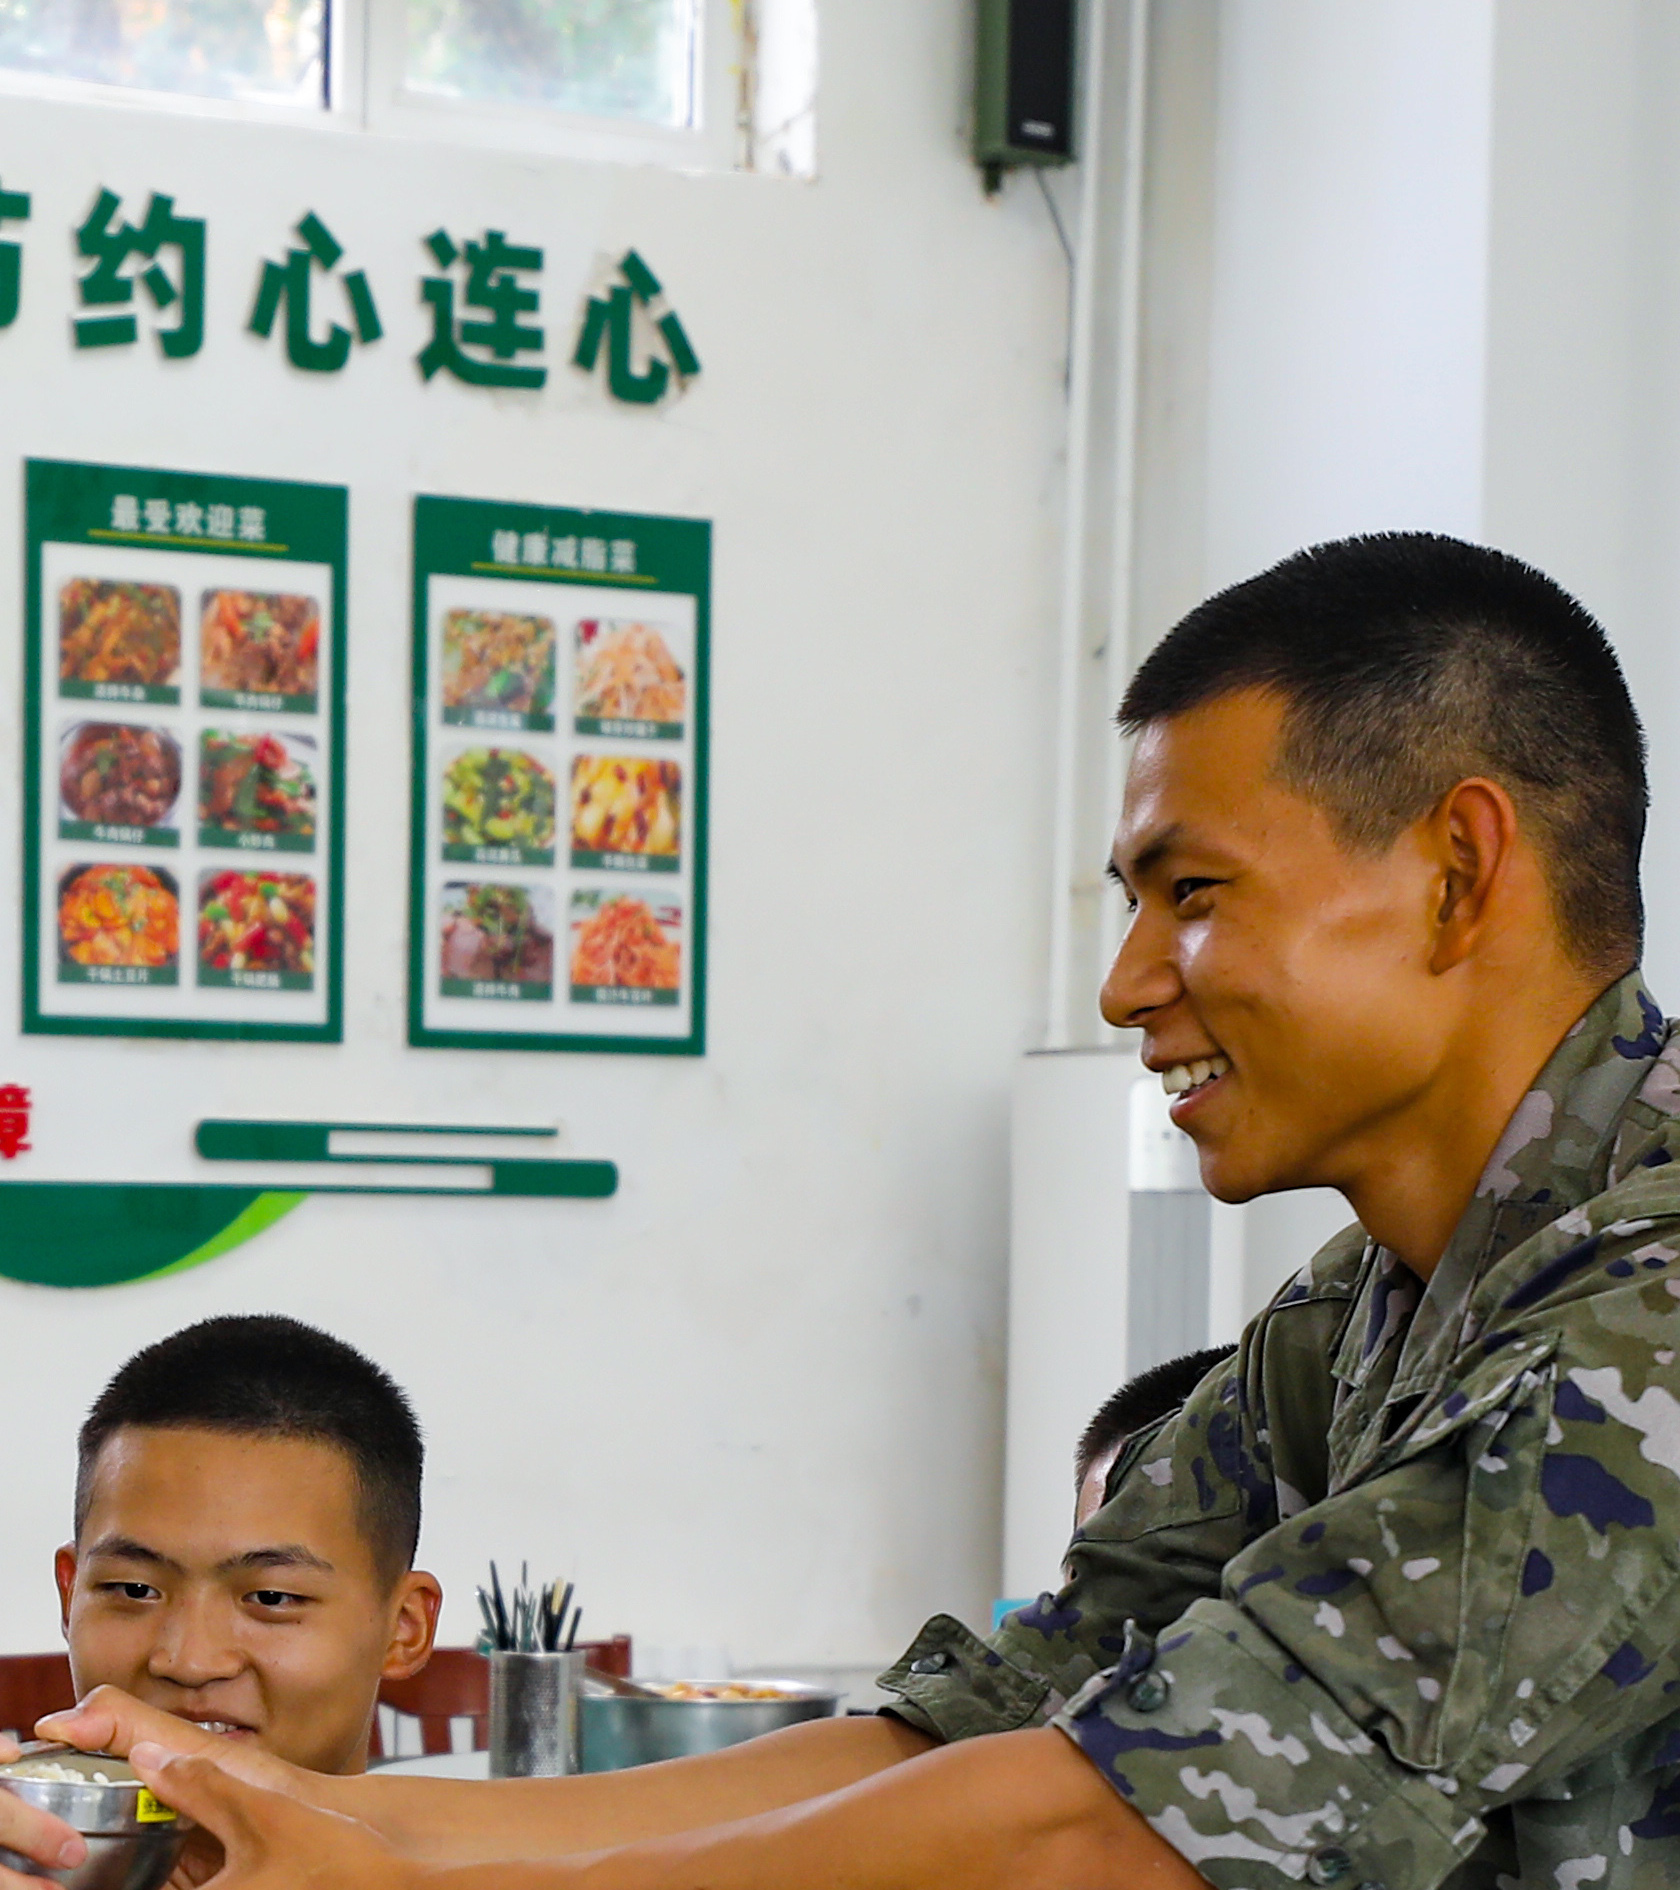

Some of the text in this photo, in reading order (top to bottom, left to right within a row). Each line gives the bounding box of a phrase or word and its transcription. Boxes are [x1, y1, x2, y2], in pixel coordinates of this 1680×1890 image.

[109, 494, 267, 541] 最受欢迎菜
[490, 529, 638, 574] 健康减脂菜
